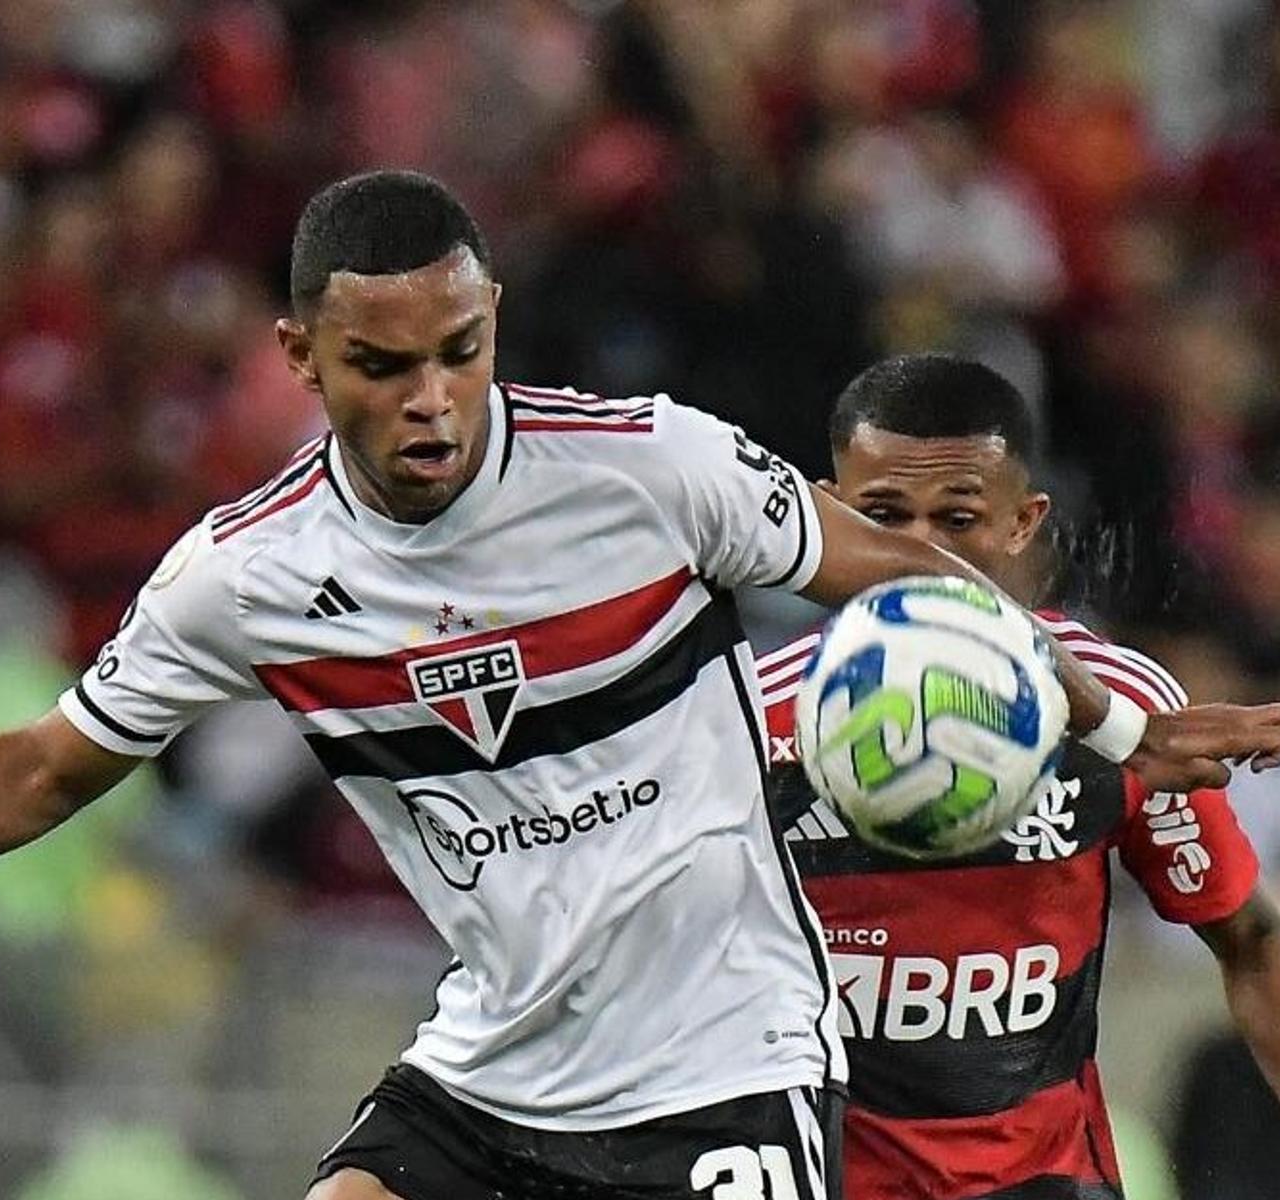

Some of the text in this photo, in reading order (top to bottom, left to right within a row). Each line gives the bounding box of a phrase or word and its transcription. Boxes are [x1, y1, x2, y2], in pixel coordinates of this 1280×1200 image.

[419, 651, 516, 694] SPFC
[426, 779, 661, 866] Sportsbet.io
[884, 944, 1061, 1041] BRB
